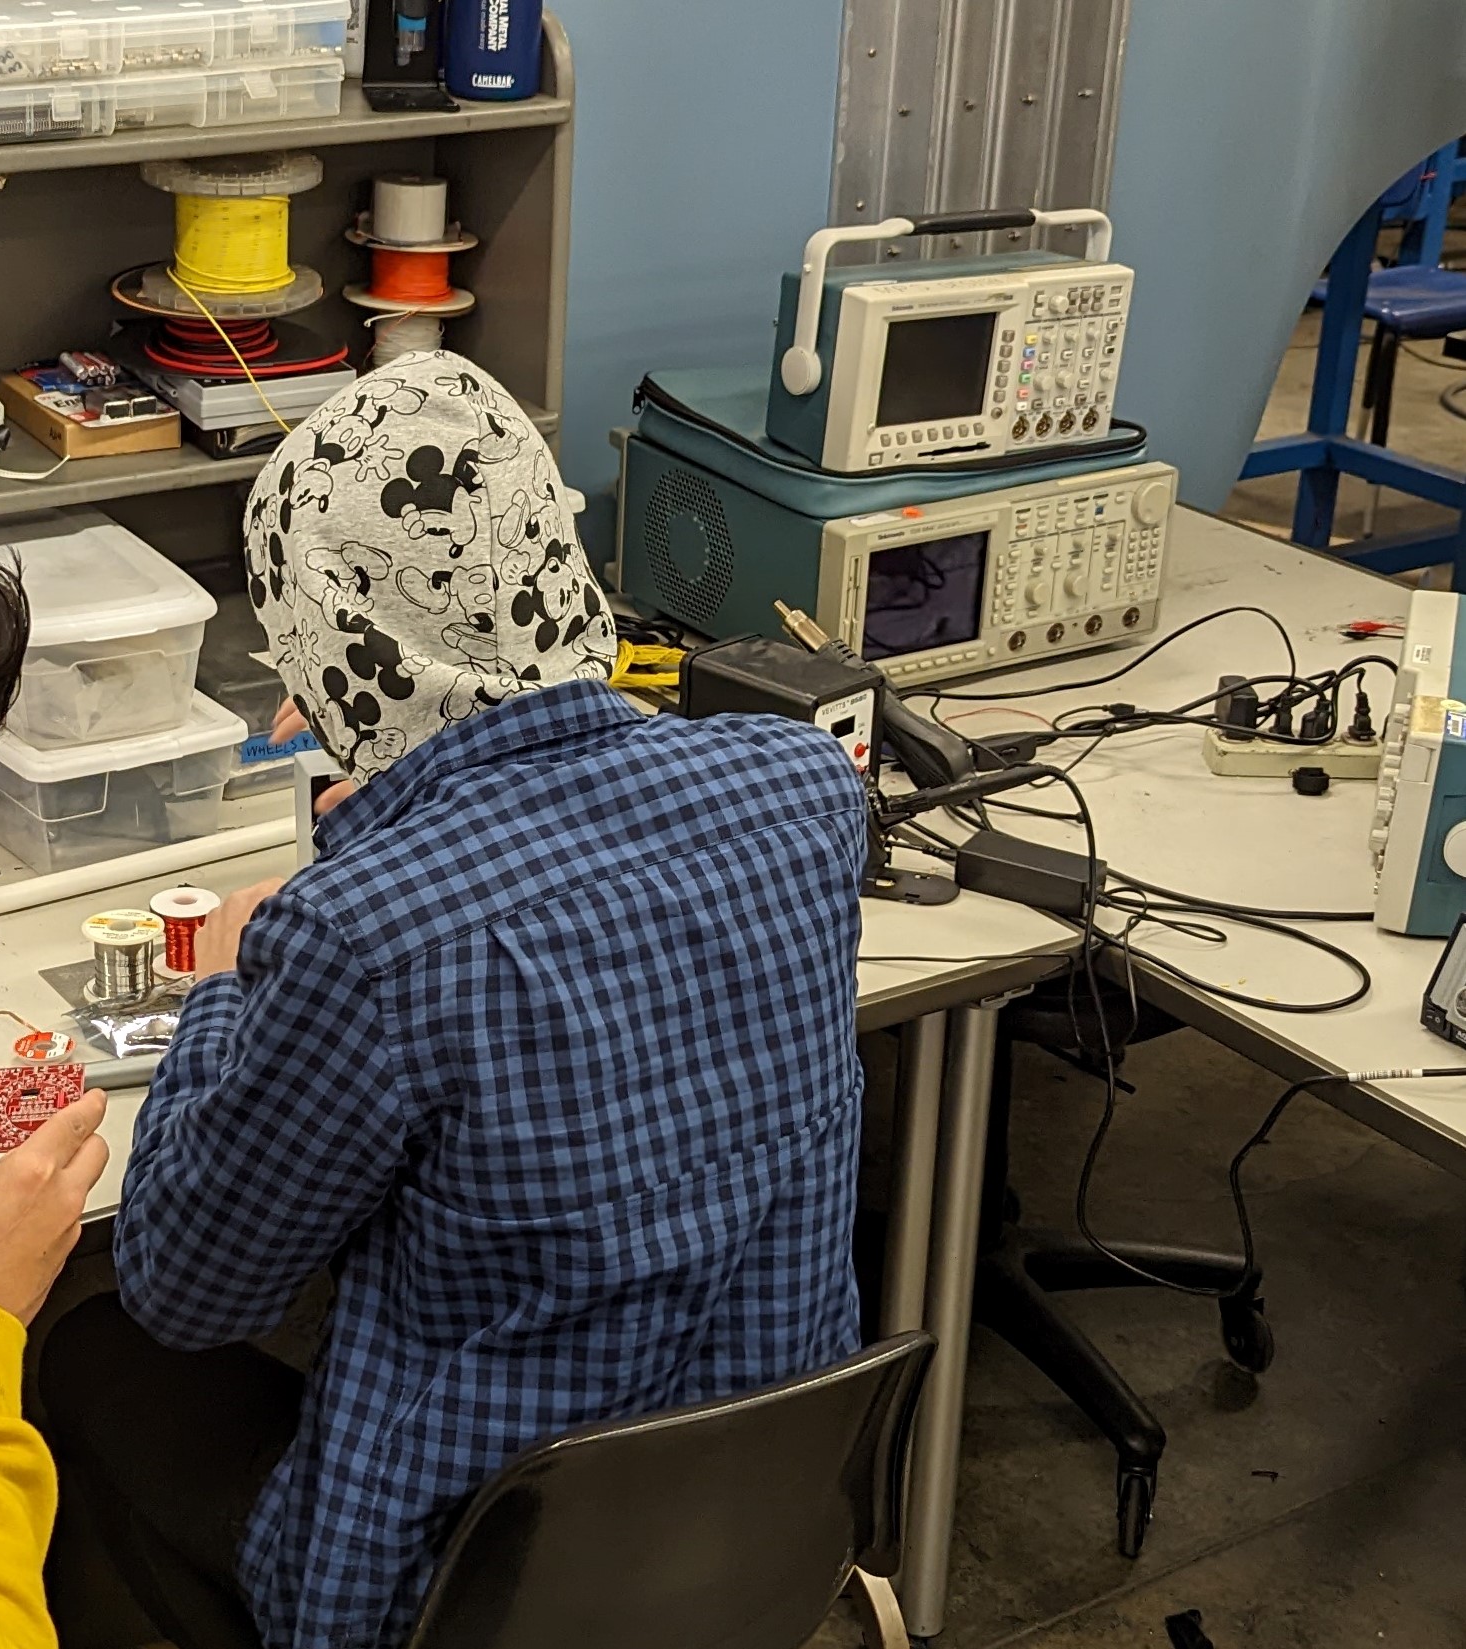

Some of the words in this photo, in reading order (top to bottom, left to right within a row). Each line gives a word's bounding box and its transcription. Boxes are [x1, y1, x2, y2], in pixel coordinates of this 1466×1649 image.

[488, 0, 499, 51] COMPANY
[498, 16, 509, 51] METAL
[471, 73, 512, 88] CAMELBAK
